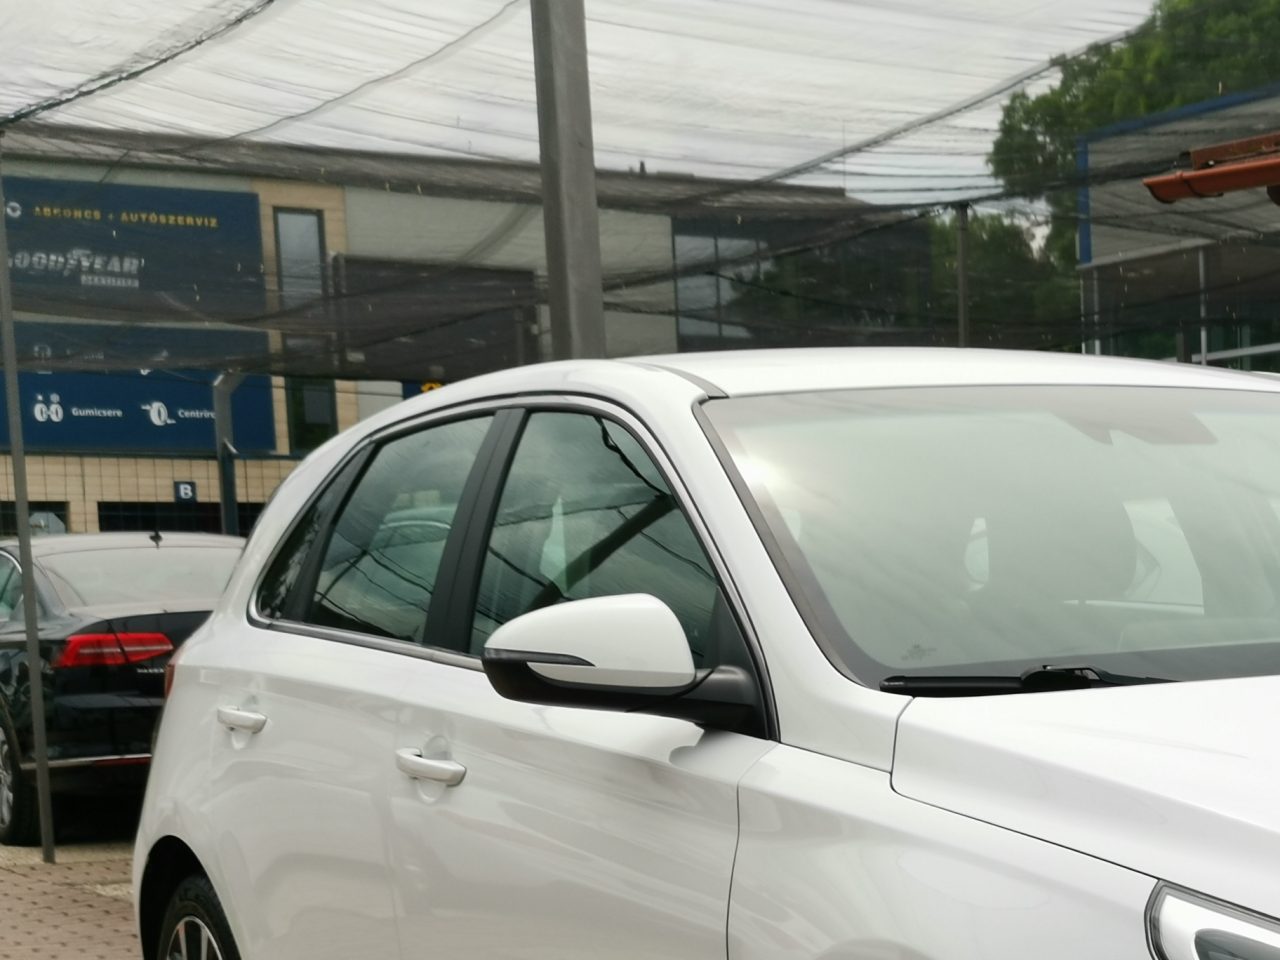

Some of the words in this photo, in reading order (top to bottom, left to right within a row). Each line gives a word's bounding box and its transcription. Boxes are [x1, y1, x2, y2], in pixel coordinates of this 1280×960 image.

[120, 212, 220, 228] AUTÓSZERVIZ
[71, 406, 123, 418] Gumicsere
[179, 484, 193, 499] B
